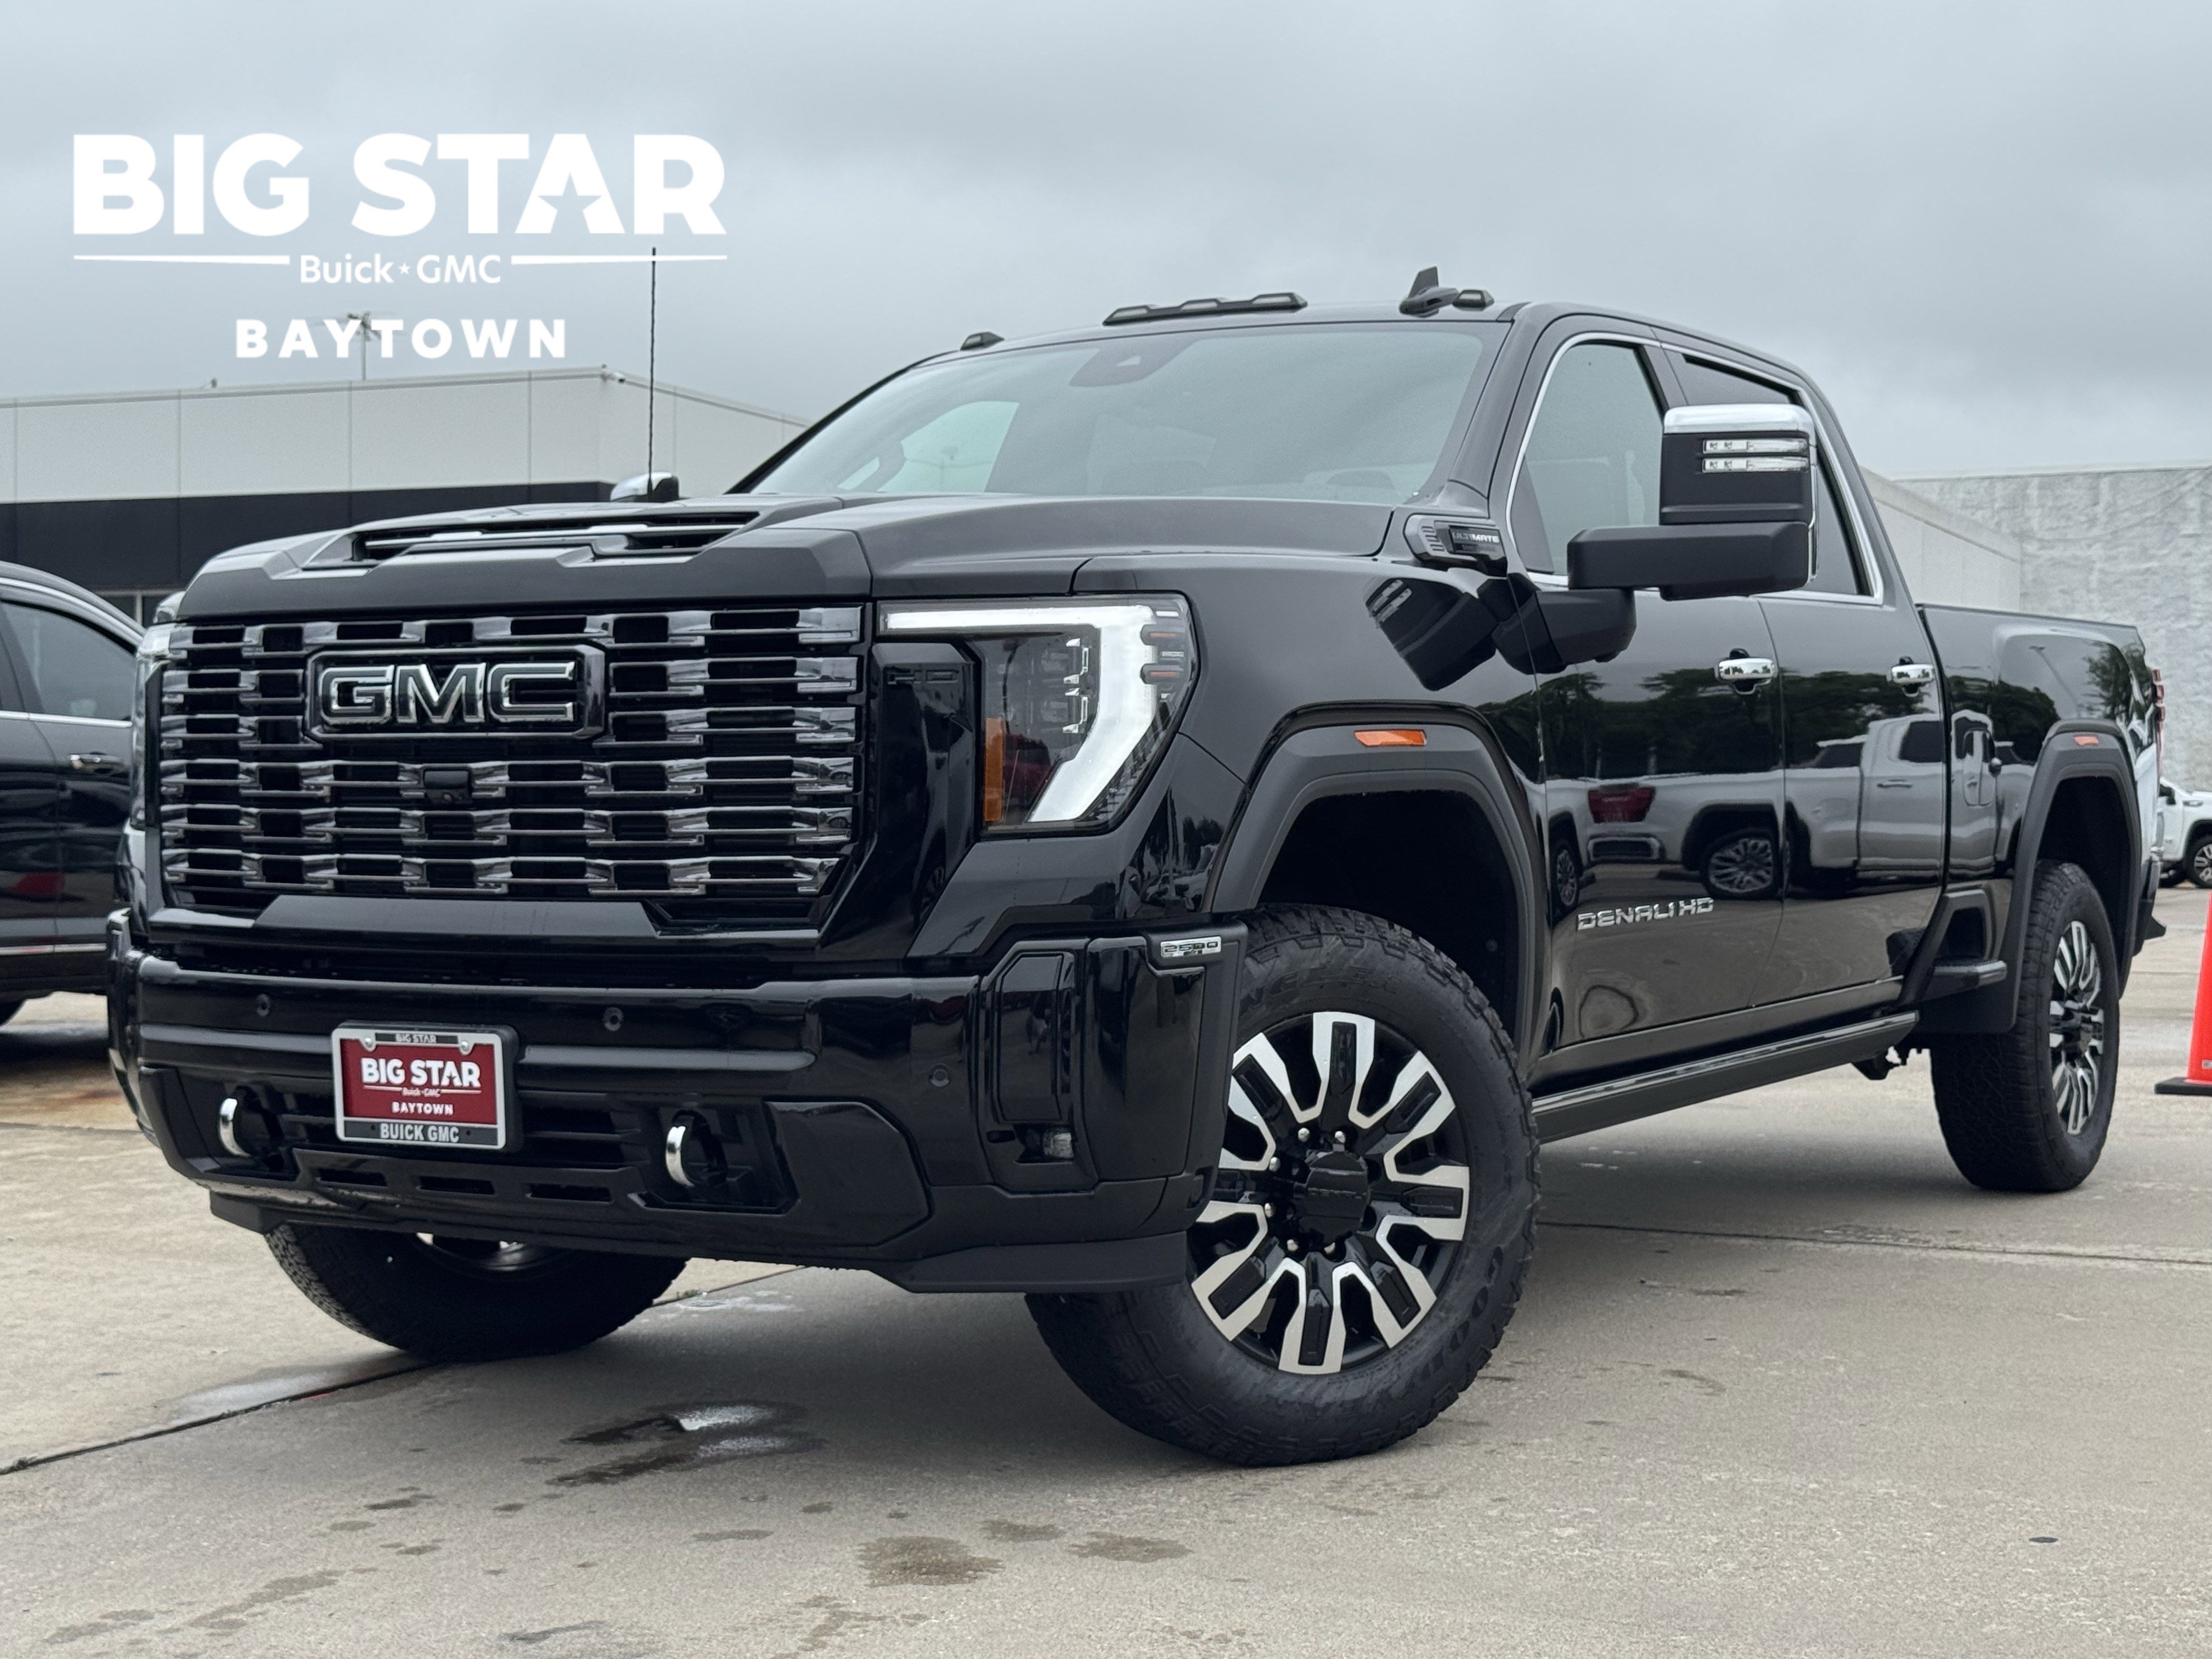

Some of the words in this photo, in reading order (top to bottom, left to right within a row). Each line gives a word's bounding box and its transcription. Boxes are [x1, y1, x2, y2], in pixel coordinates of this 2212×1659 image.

[318, 662, 575, 725] GMC
[1577, 902, 1674, 930] DENALI
[1678, 897, 1714, 917] HD
[1164, 941, 1218, 953] 2500
[396, 1034, 412, 1043] BIG
[413, 1034, 437, 1044] STAR
[361, 1057, 406, 1085] BIG
[410, 1059, 481, 1088] STAR
[392, 1101, 454, 1115] BAYTOWN
[380, 1122, 425, 1141] BUICK
[427, 1125, 460, 1143] GMC
